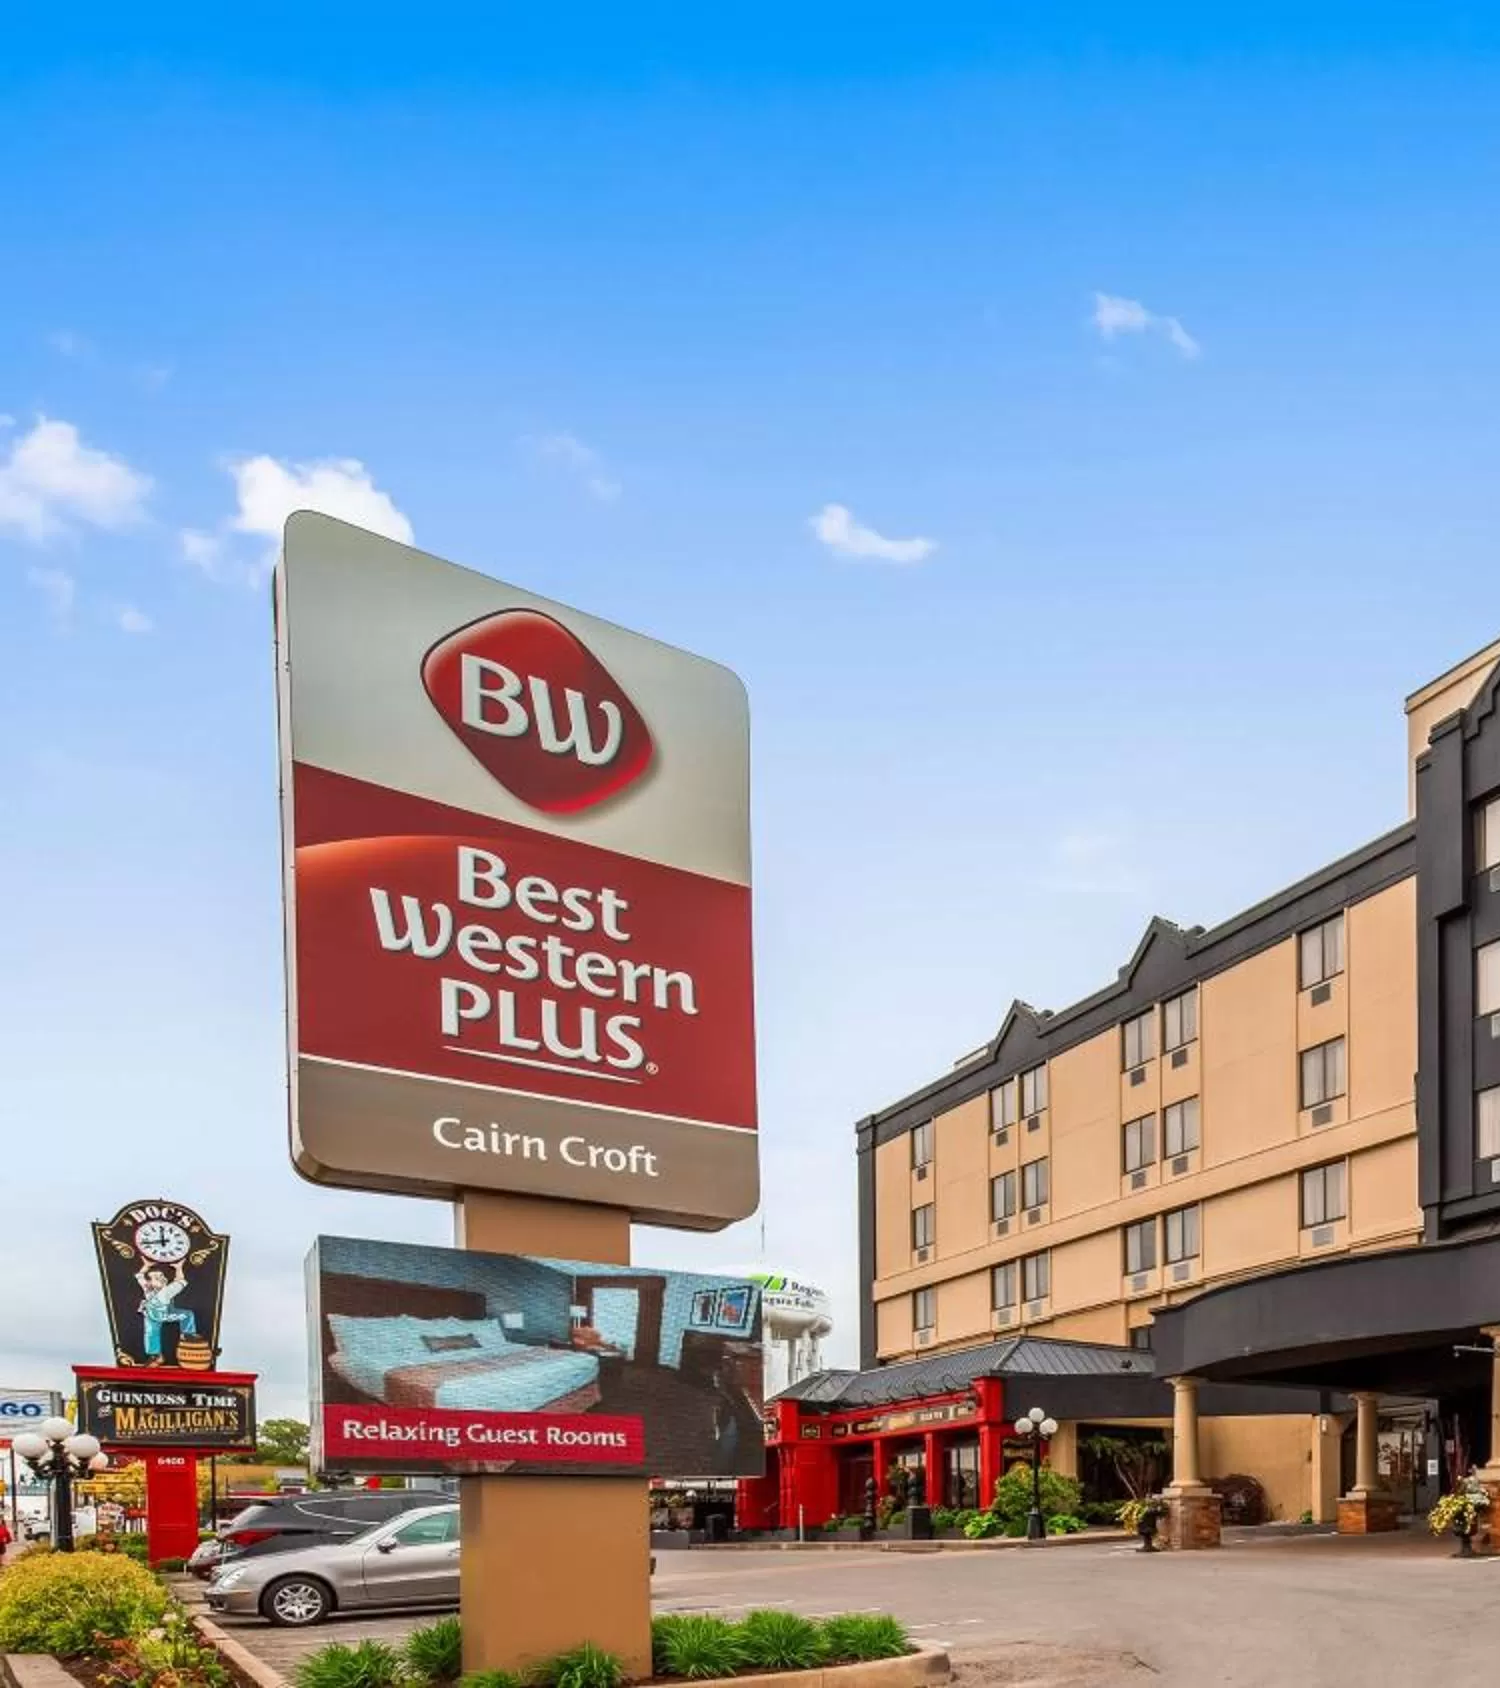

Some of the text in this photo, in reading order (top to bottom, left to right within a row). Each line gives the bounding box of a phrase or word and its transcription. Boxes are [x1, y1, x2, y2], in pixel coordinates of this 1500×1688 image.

[461, 653, 623, 766] BW
[457, 846, 631, 942] Best
[369, 888, 699, 1015] Western
[441, 977, 645, 1070] PLUS
[433, 1117, 660, 1177] Cairn Croft
[96, 1389, 237, 1408] GUINNESS TIME
[115, 1407, 239, 1430] MAGILLIGAN'S
[342, 1419, 627, 1447] Relaxing Guest Rooms
